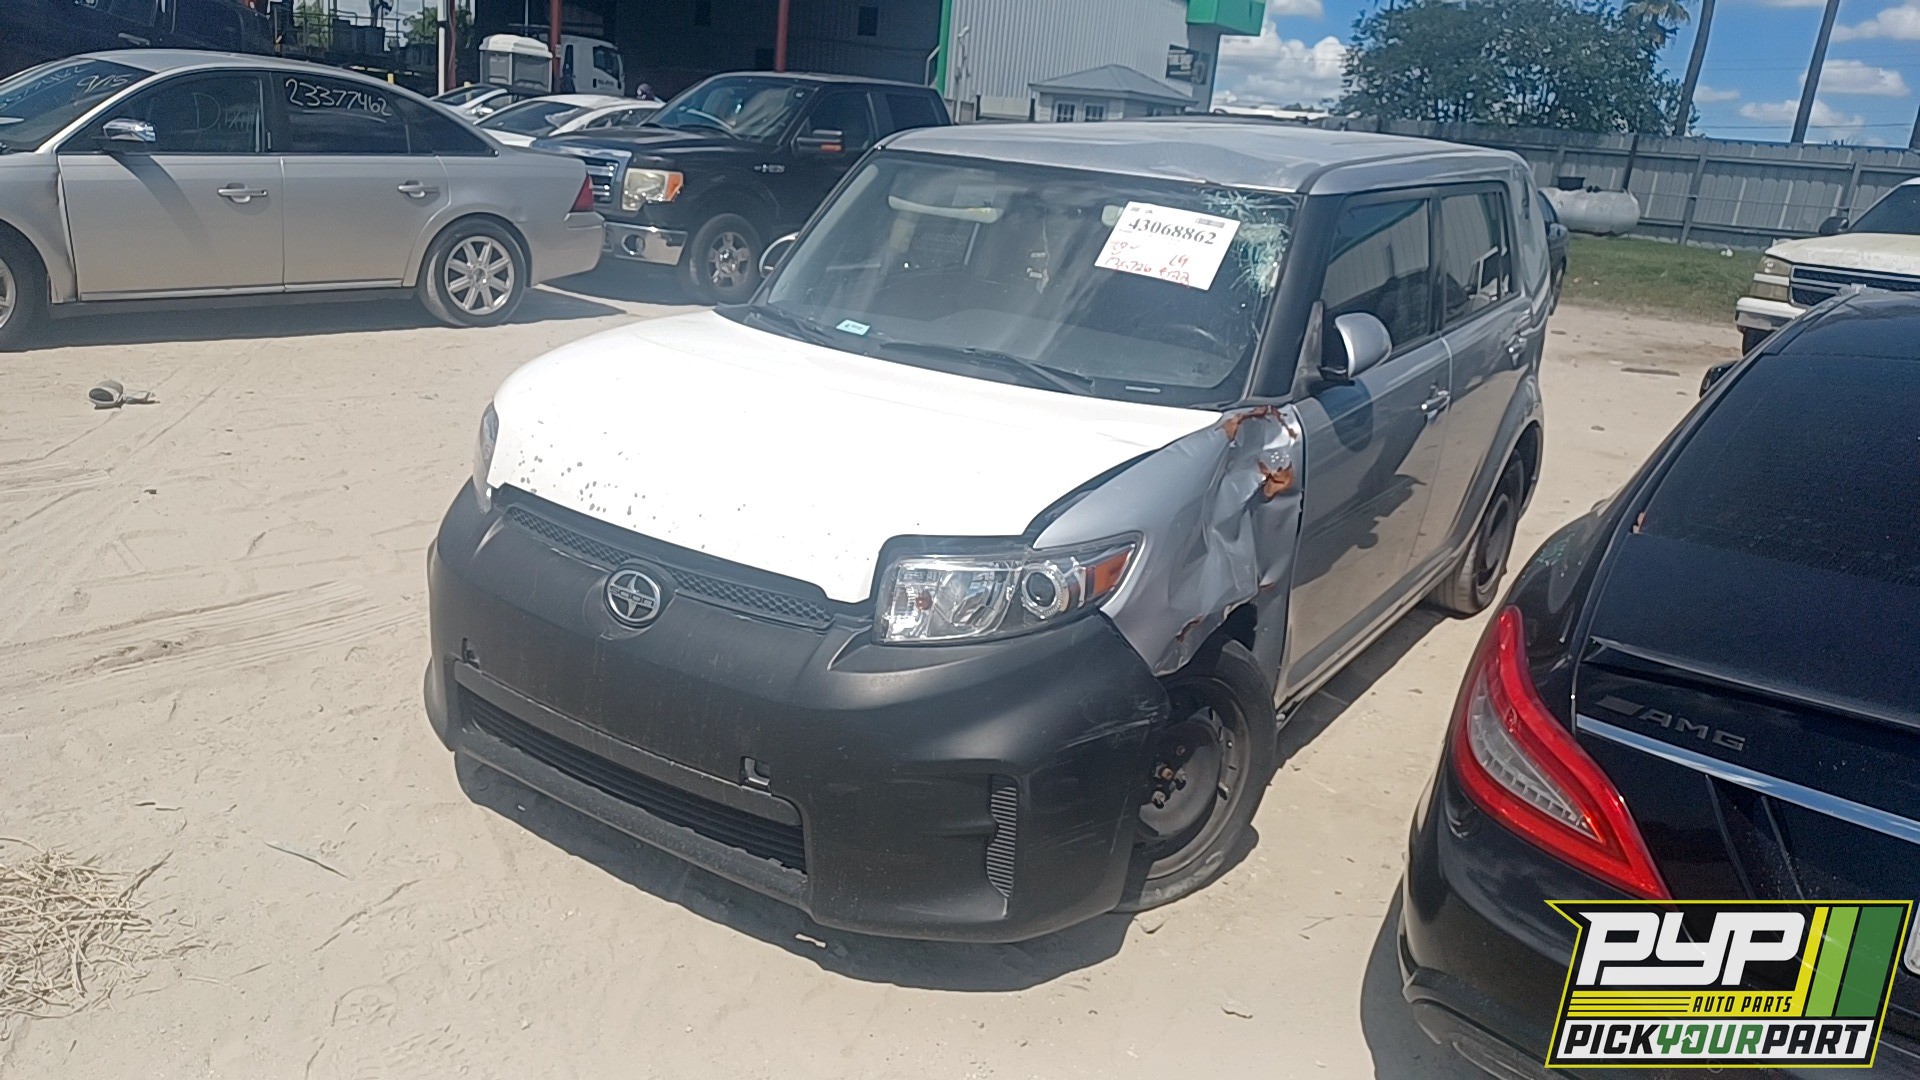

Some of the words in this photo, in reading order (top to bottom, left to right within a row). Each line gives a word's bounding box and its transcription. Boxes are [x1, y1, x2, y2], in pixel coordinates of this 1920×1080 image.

[285, 79, 392, 116] 23377462
[1128, 218, 1217, 245] 43068862
[1638, 708, 1746, 751] AMG
